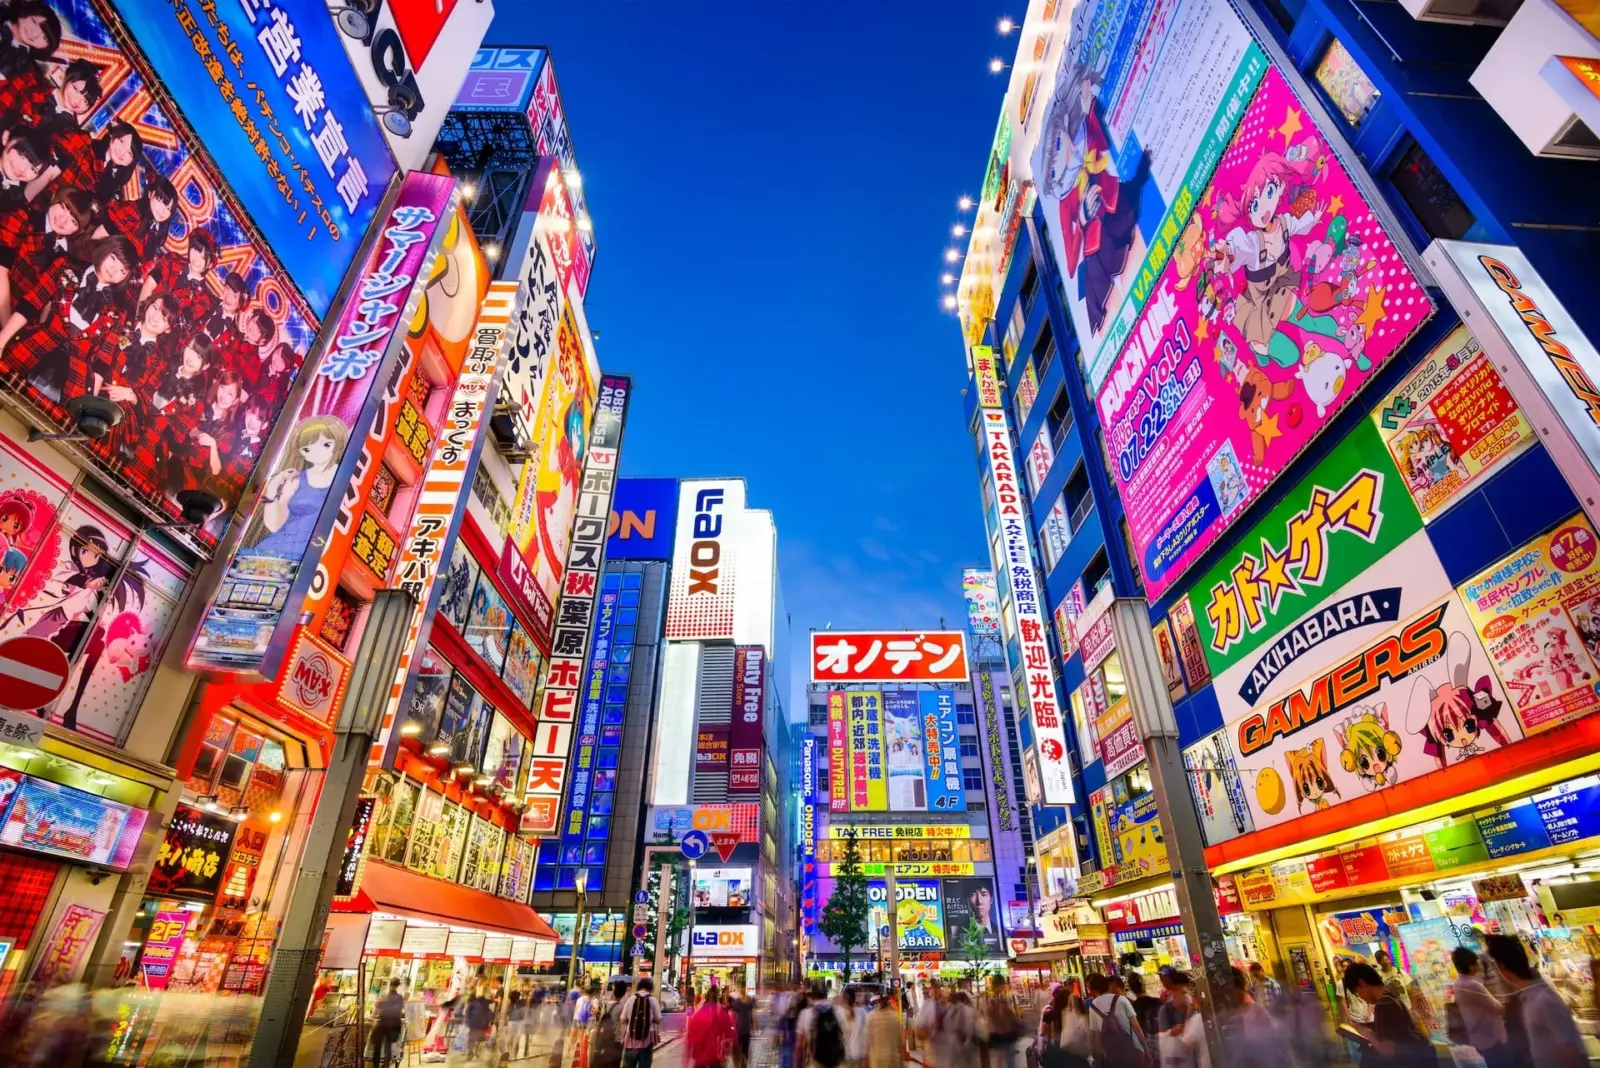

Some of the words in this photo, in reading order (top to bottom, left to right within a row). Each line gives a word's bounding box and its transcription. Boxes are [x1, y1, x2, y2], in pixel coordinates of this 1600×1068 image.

[319, 206, 435, 382] サマージャンボ
[469, 328, 501, 374] 買取り
[613, 379, 627, 424] HOBBY
[977, 358, 998, 404] まんが喫茶
[593, 379, 614, 446] PARADISE
[1119, 400, 1167, 482] 07.22
[988, 431, 1020, 515] TAKARADA
[1410, 445, 1451, 481] SAMPLE
[1011, 565, 1038, 615] 免税商店
[815, 633, 961, 674] オノデン
[1251, 594, 1383, 694] AKIHABARA
[745, 650, 763, 685] Duty
[1019, 618, 1060, 730] 歓迎光臨
[1237, 600, 1450, 758] GAMERS
[735, 683, 743, 705] Store
[743, 688, 761, 723] Free
[830, 694, 843, 720] 免税
[938, 694, 955, 746] エアコン
[731, 773, 758, 784] 면세점
[733, 752, 758, 765] 免税
[803, 739, 814, 797] Panasonic
[934, 796, 958, 808] 4F
[237, 826, 267, 852] 入口
[716, 837, 736, 847] 止まれ
[804, 804, 814, 855] ONODEN
[835, 828, 858, 837] TAX
[862, 828, 893, 837] FREE
[895, 827, 923, 837] 免税店
[896, 864, 929, 874] エアコン
[151, 921, 184, 942] 2F
